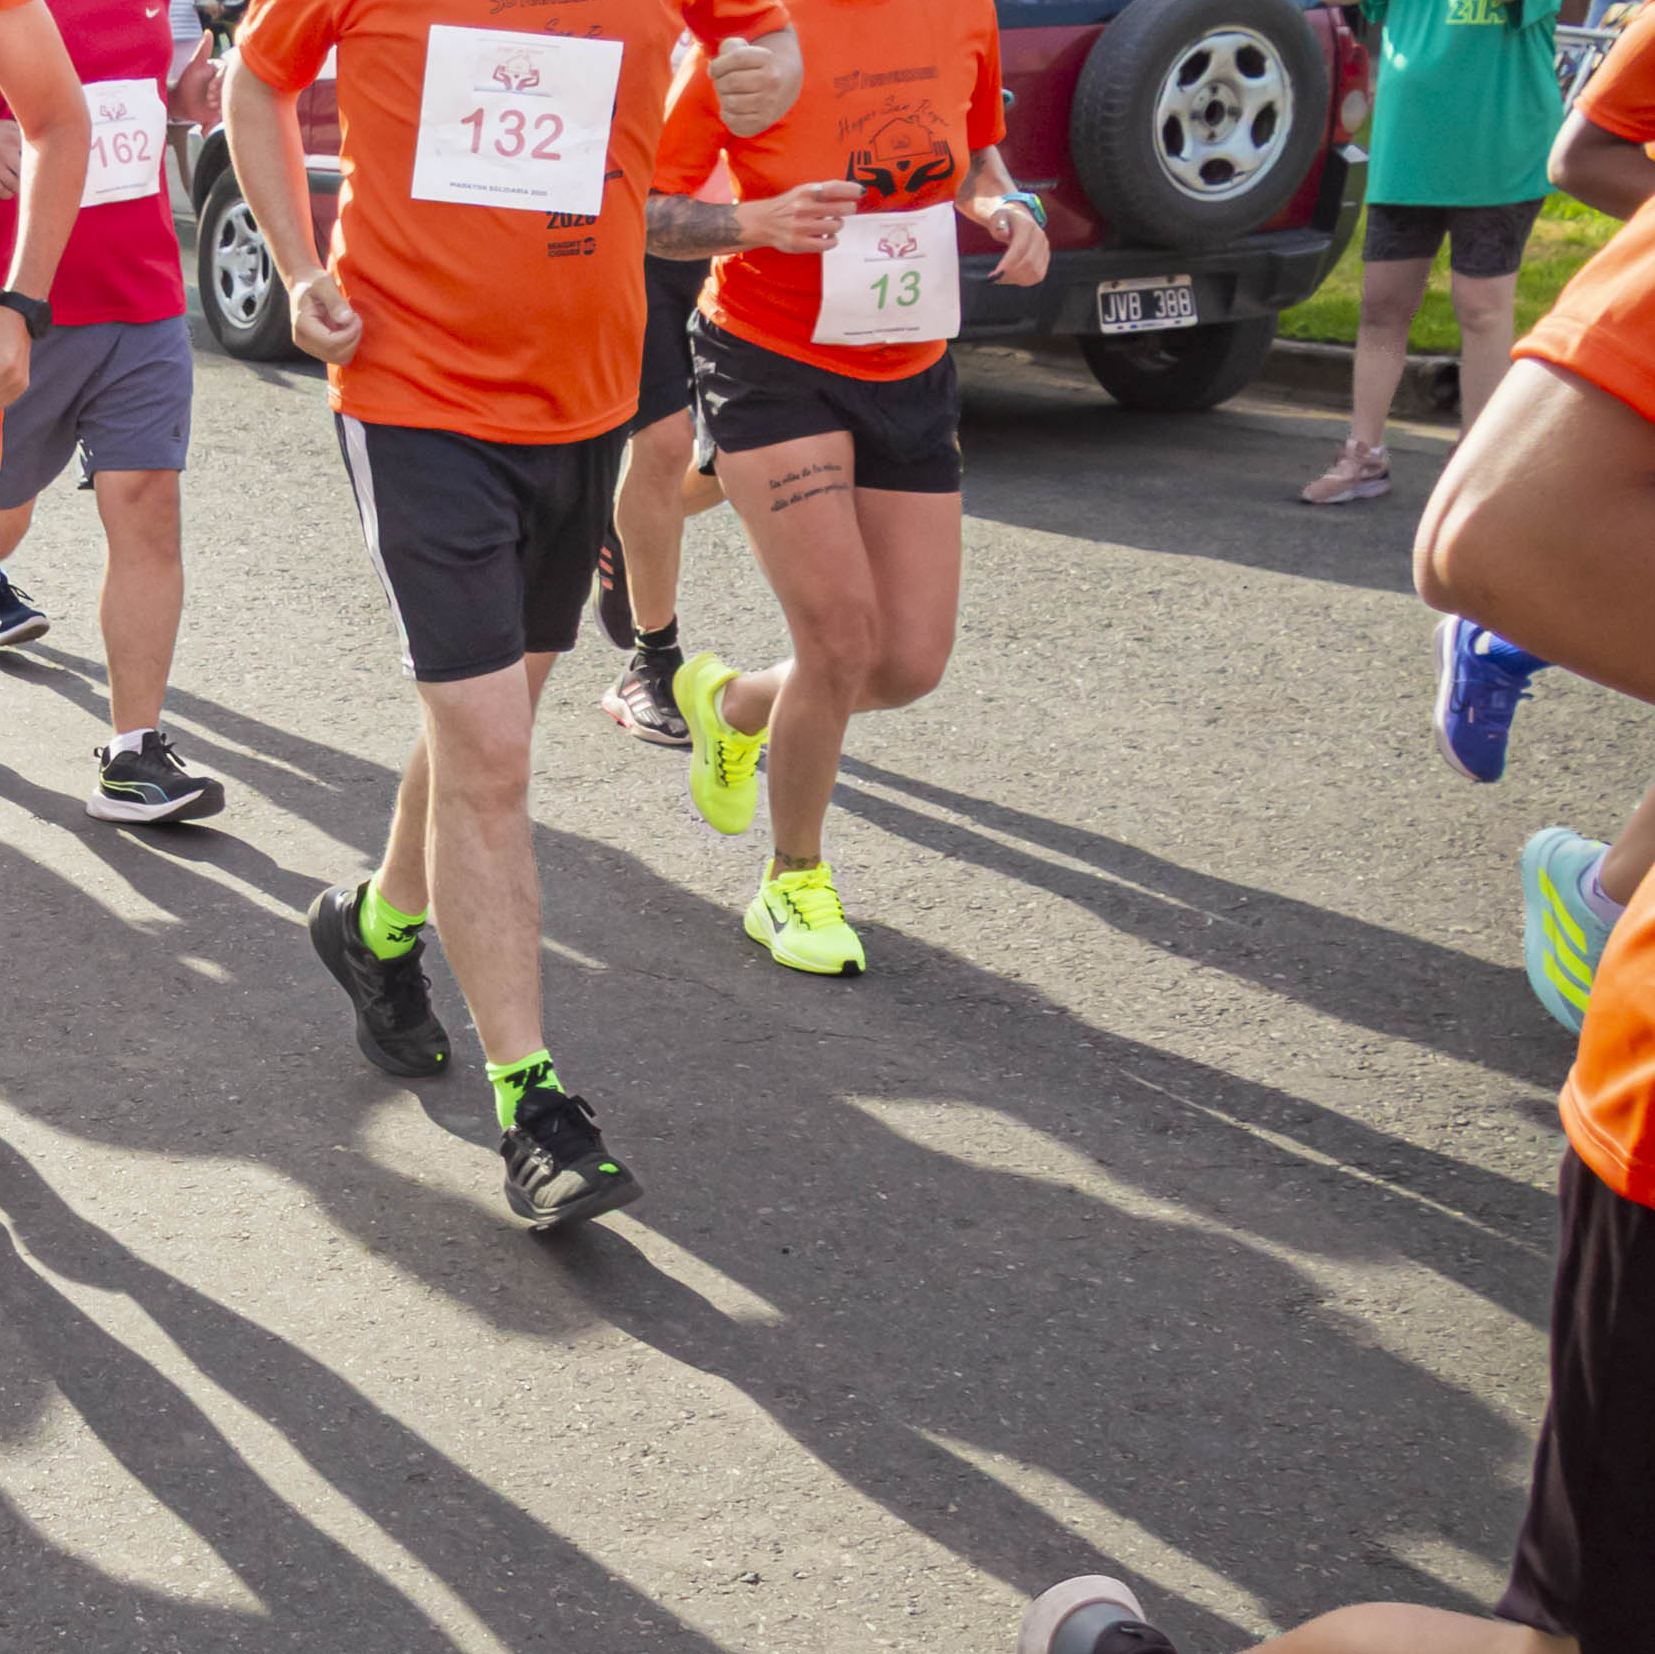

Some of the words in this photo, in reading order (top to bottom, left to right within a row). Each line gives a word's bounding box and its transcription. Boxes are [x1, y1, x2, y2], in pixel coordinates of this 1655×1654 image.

[90, 129, 151, 168] 162
[460, 107, 565, 161] 132
[869, 270, 922, 310] 13
[1104, 292, 1142, 322] JVB
[1153, 287, 1192, 318] 388
